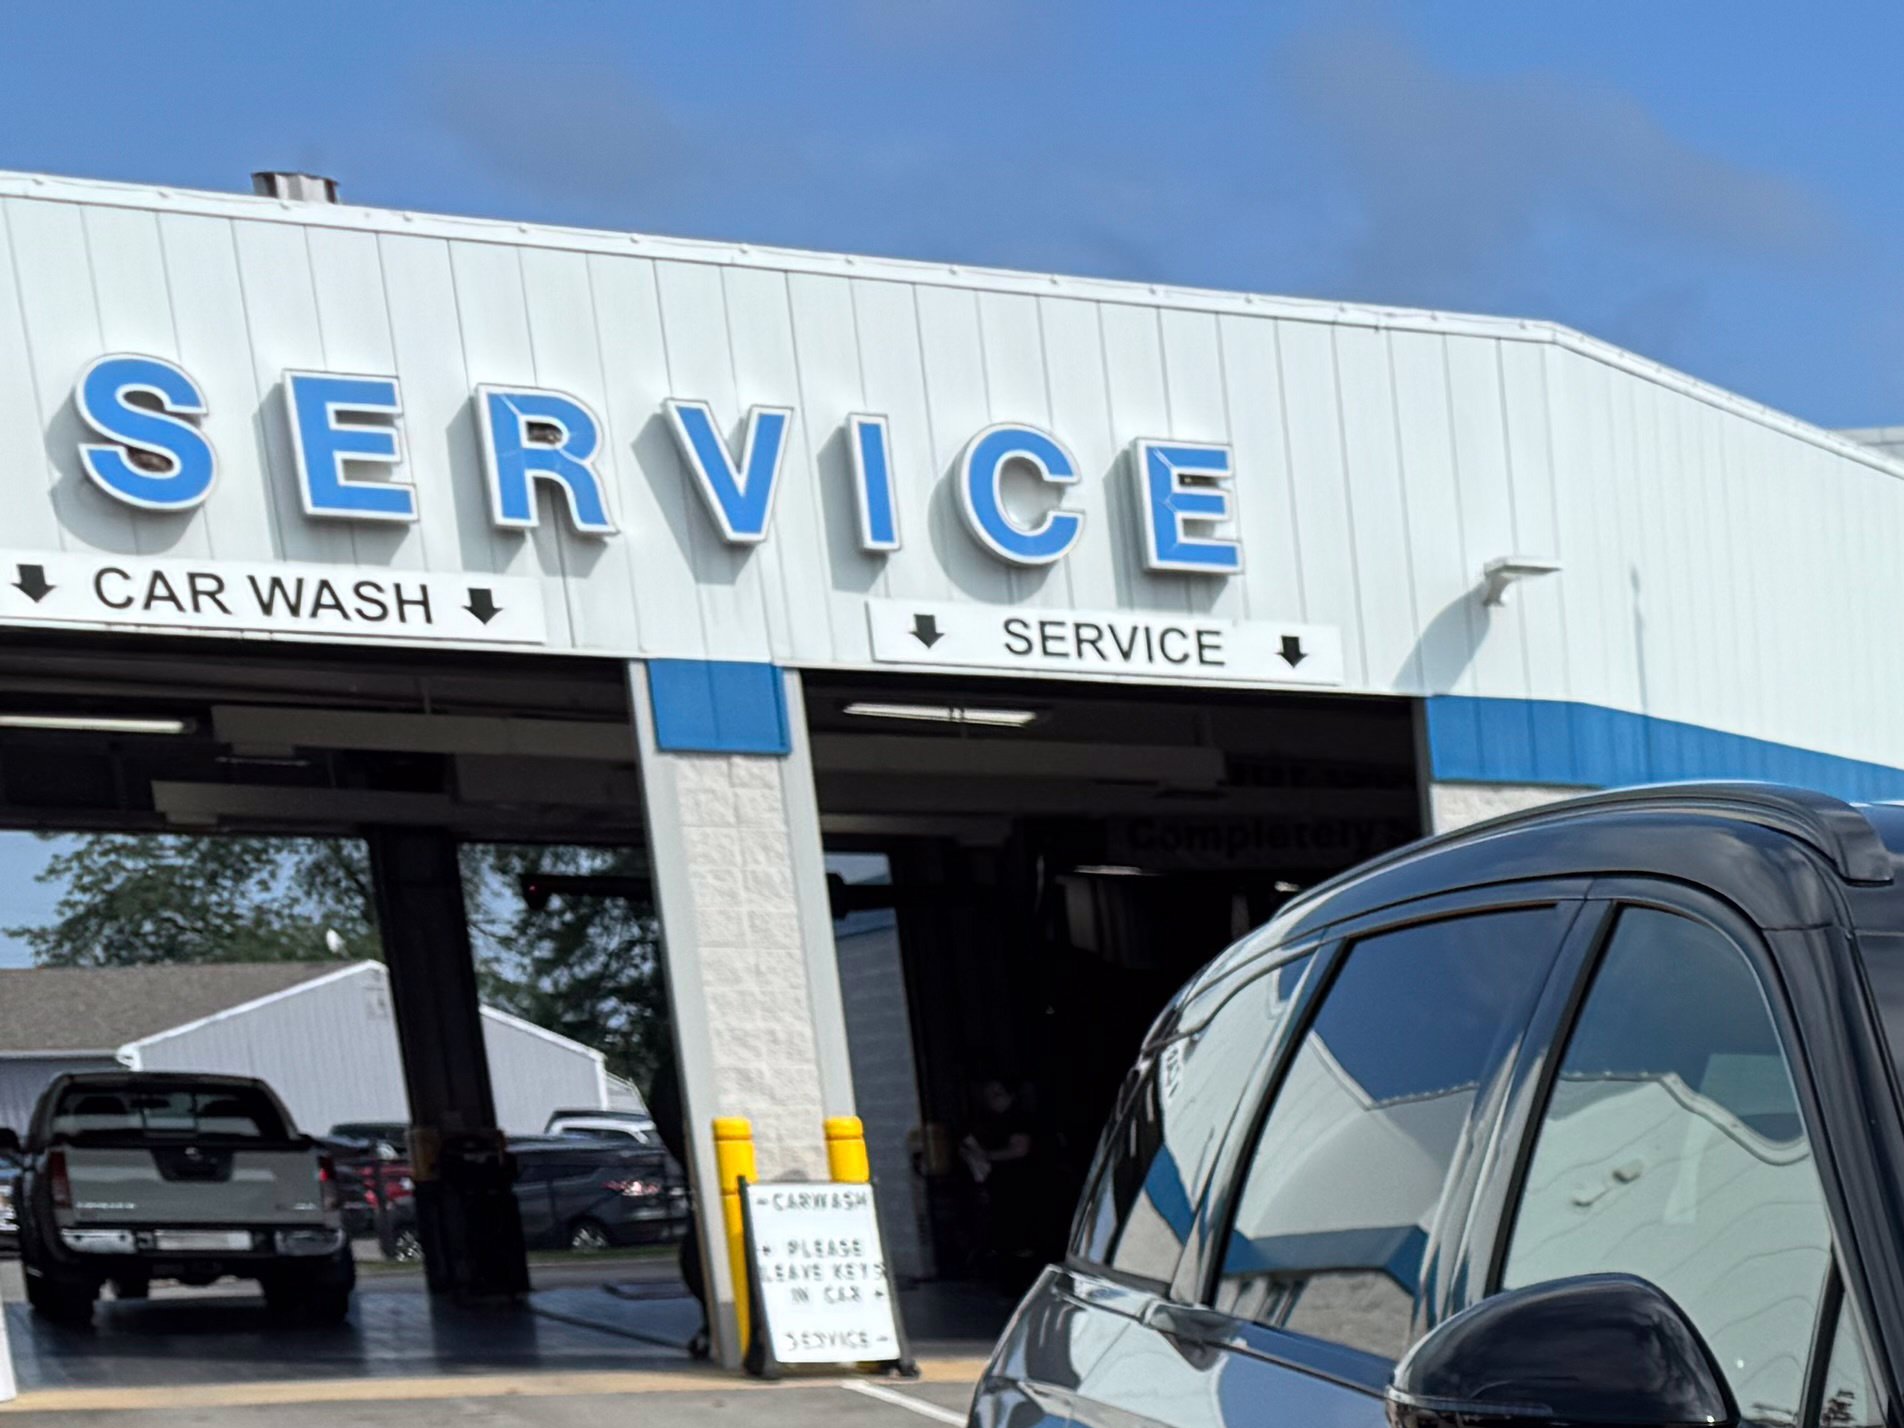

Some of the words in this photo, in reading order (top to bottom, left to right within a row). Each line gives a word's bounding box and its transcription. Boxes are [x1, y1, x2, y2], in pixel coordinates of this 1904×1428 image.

[76, 352, 1243, 574] SERVICE
[93, 567, 232, 615] CAR
[246, 574, 433, 625] WASH
[1003, 618, 1226, 666] SERVICE
[772, 1192, 867, 1211] CARWASH
[787, 1239, 864, 1258] PLEASE
[761, 1263, 823, 1282] LEAVE
[834, 1262, 886, 1281] KEYS
[824, 1285, 862, 1304] CAR
[785, 1331, 871, 1351] SERVICE
